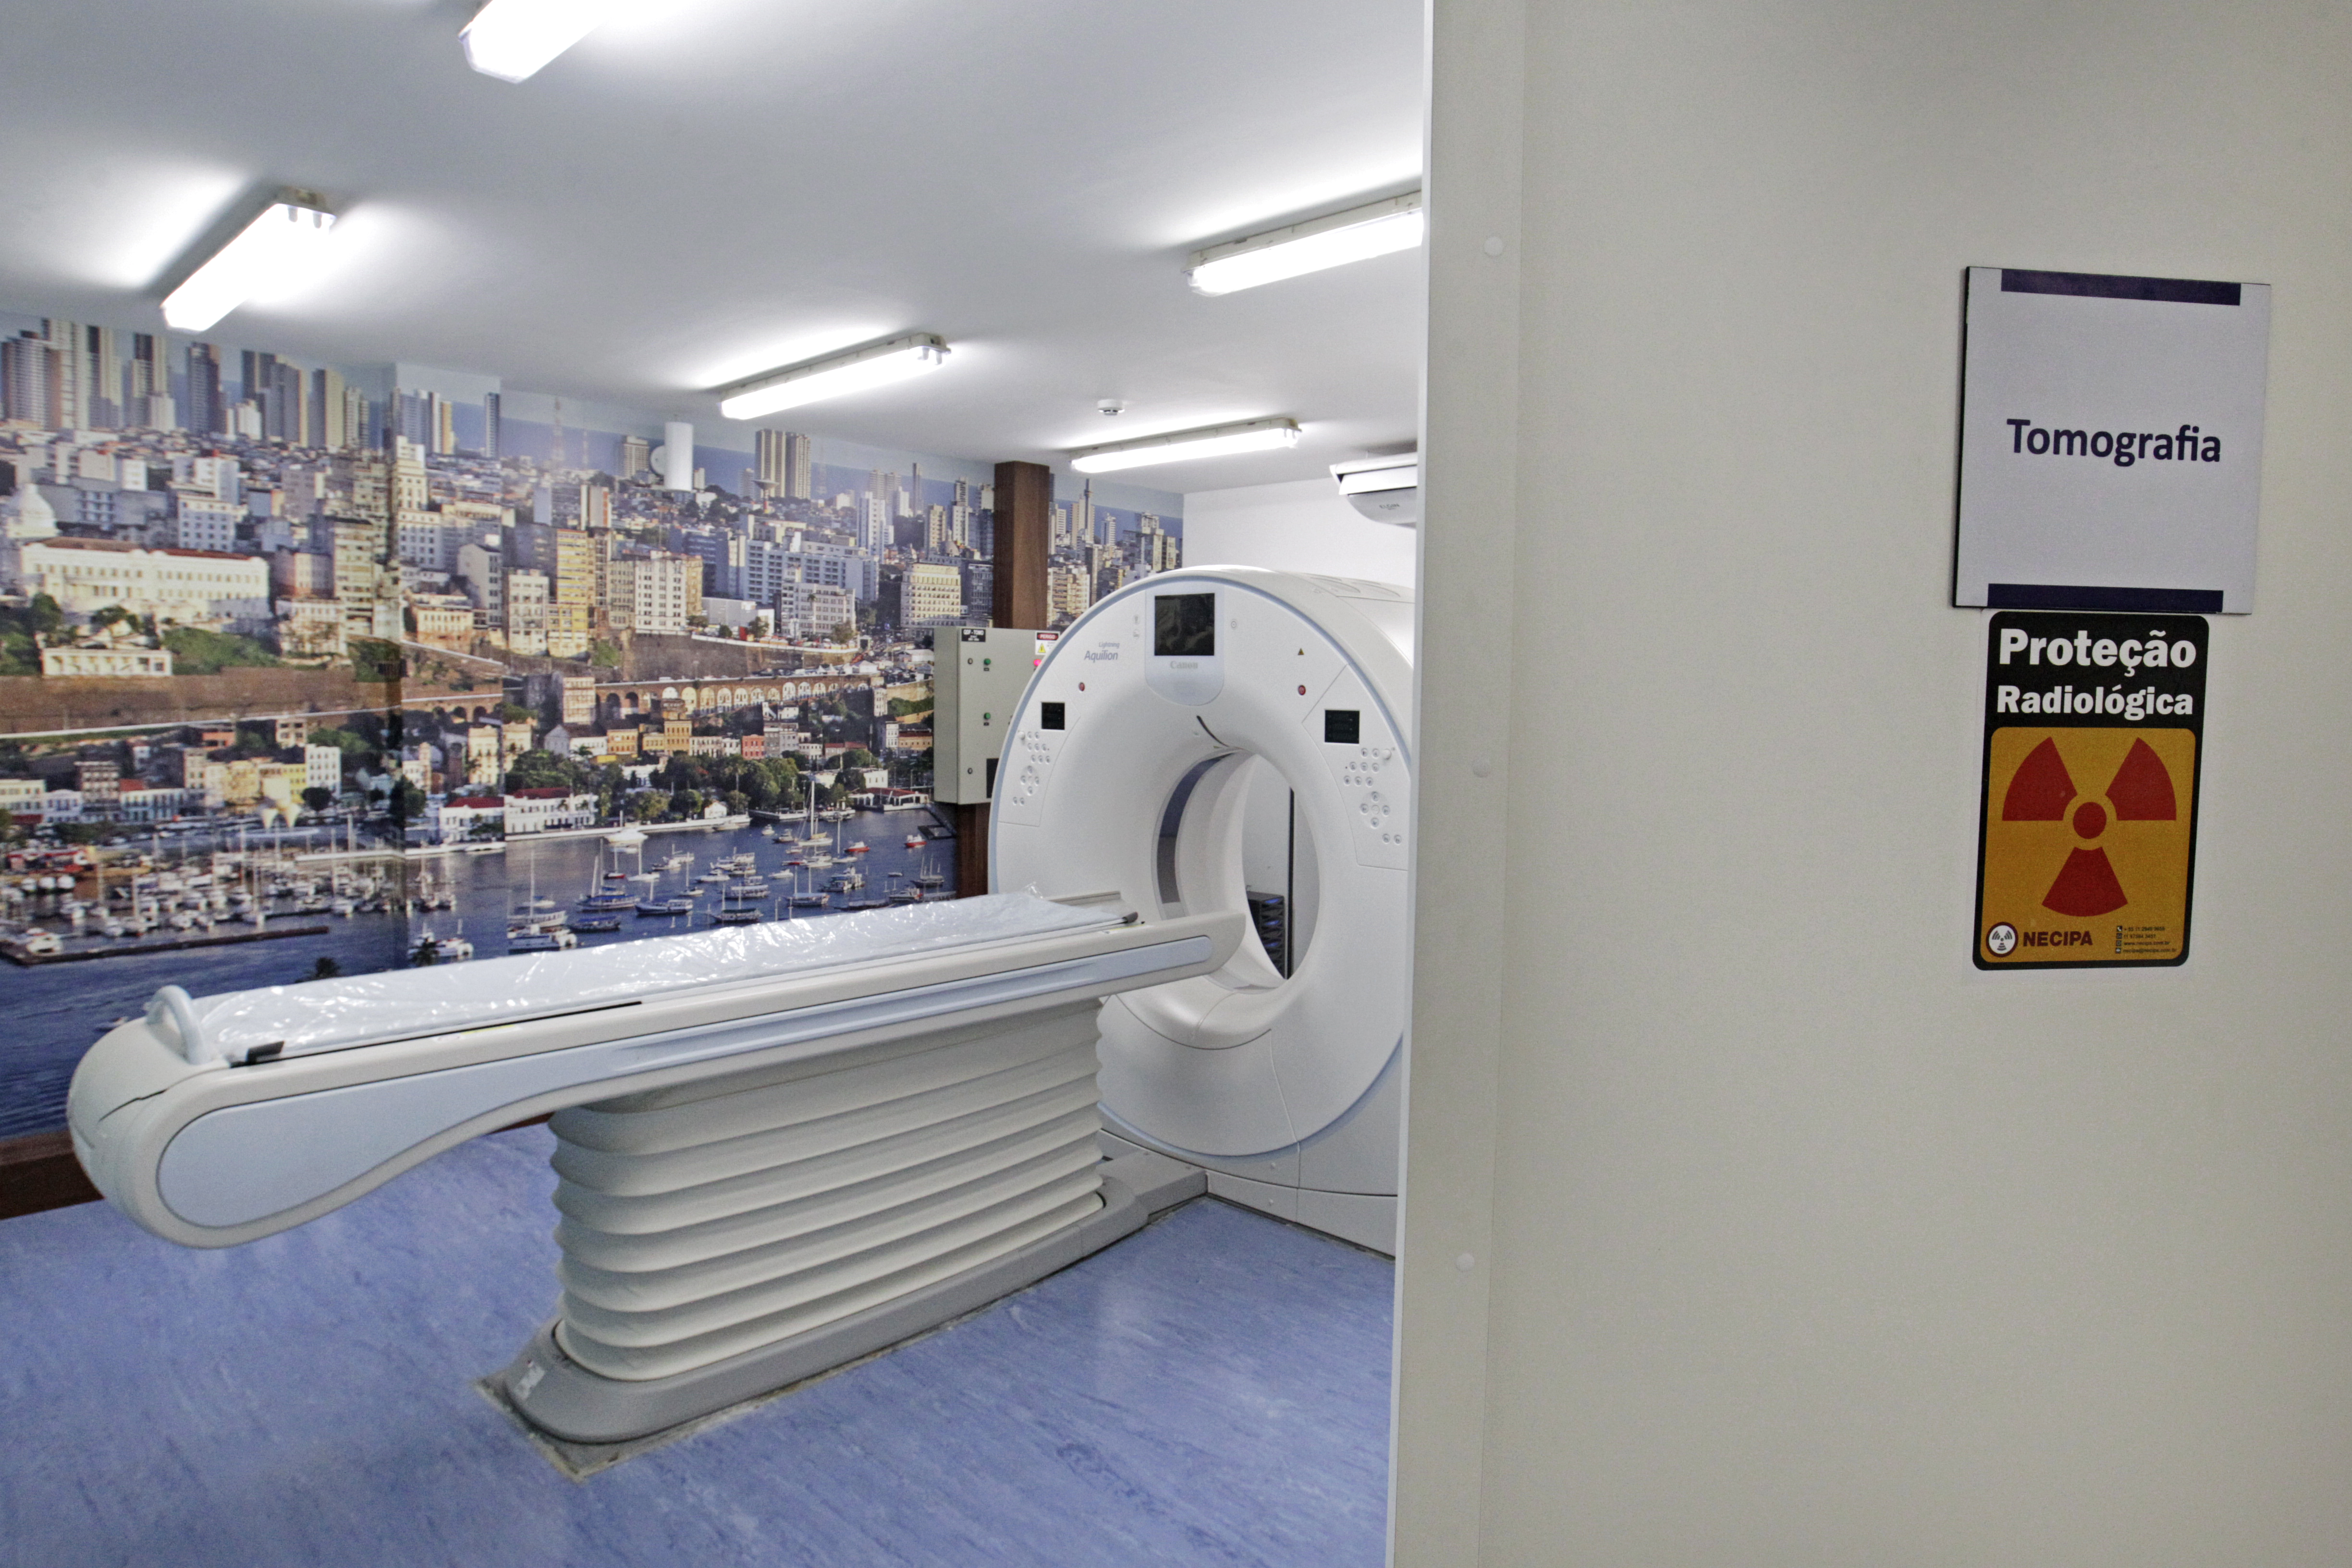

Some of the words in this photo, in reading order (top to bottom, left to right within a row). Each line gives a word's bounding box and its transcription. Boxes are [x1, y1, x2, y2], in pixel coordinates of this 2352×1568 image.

[2007, 418, 2221, 467] Tomografia
[1084, 649, 1118, 663] Aquilion
[1170, 661, 1199, 669] Canon
[1999, 629, 2196, 676] Proteção
[1997, 684, 2193, 721] Radiológica
[2022, 930, 2094, 947] NECIPA
